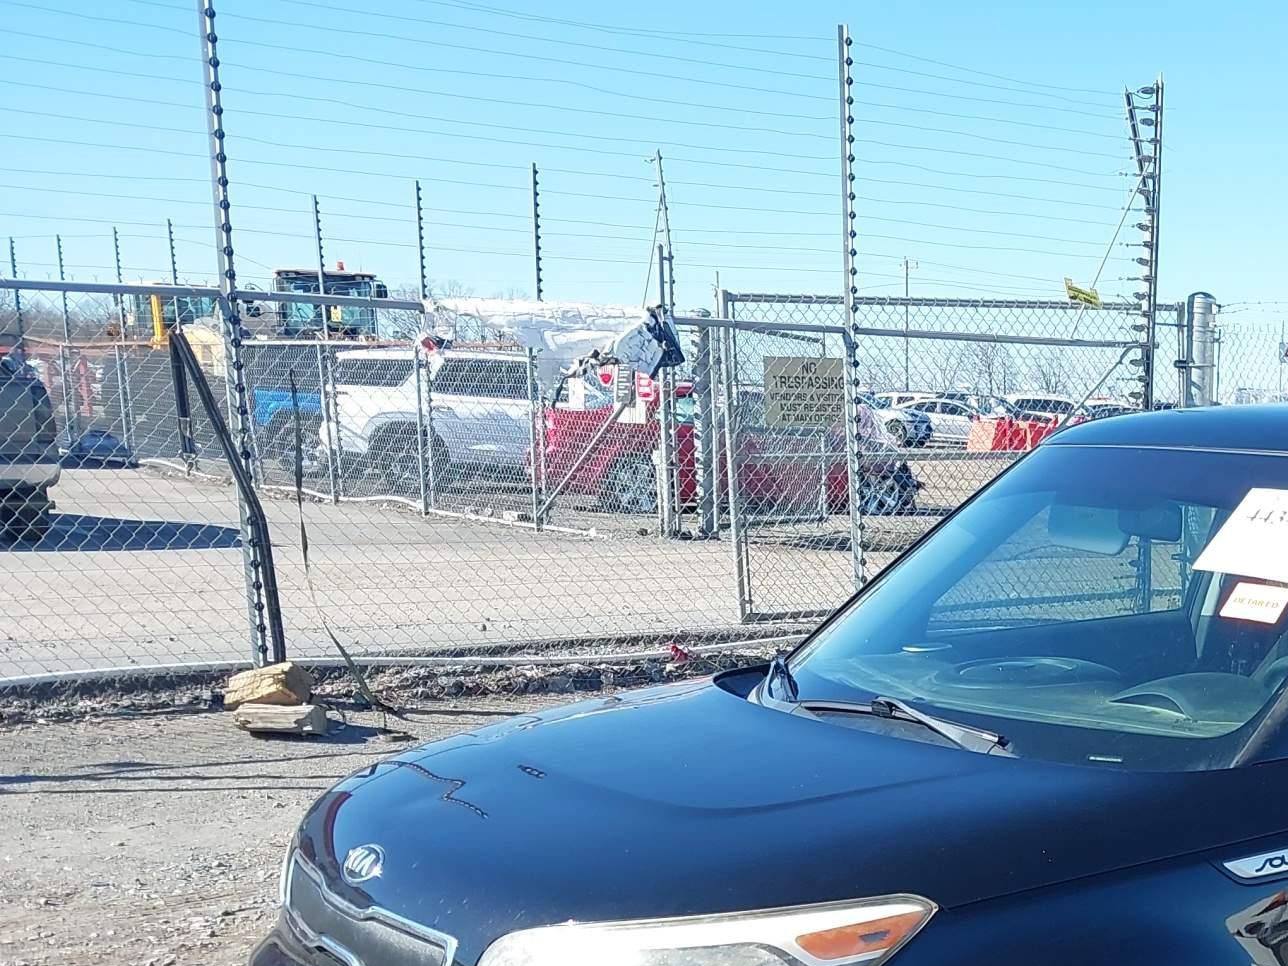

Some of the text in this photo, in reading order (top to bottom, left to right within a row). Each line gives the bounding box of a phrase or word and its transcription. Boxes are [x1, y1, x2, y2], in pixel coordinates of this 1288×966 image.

[801, 361, 817, 375] NO
[773, 375, 844, 389] TRESPASSING
[769, 392, 808, 401] VENDORS
